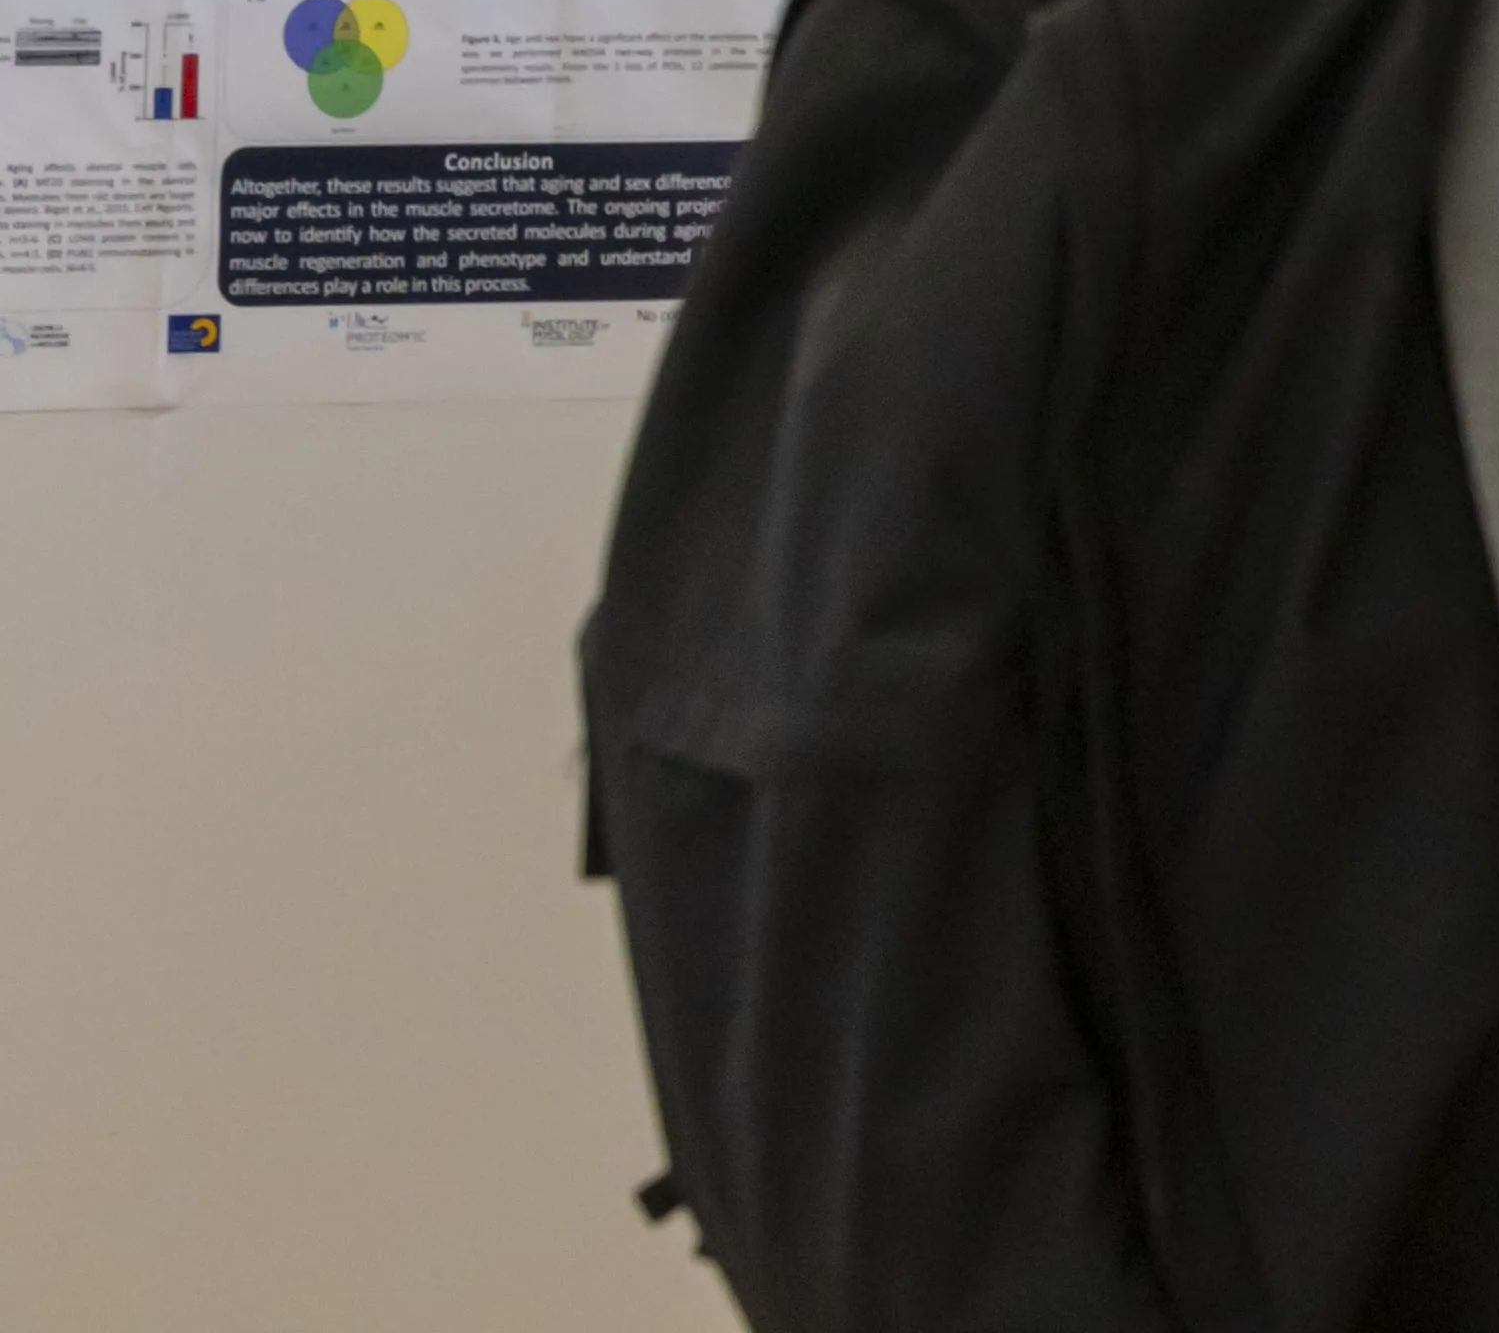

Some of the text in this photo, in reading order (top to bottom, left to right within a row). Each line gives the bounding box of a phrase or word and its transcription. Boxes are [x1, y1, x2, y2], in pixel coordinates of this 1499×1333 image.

[444, 151, 554, 172] Conclusion
[230, 178, 322, 199] Altogether,
[326, 177, 373, 195] these
[376, 176, 433, 194] results
[435, 177, 498, 196] suggest
[539, 177, 585, 196] aging
[624, 178, 652, 192] sex
[230, 198, 671, 222] major effects muscle secretome. The ongoing
[229, 221, 712, 245] now identify secreted molecules during agin
[228, 248, 693, 274] muscle regeneration phenotype understand
[228, 277, 531, 298] differences play role process.
